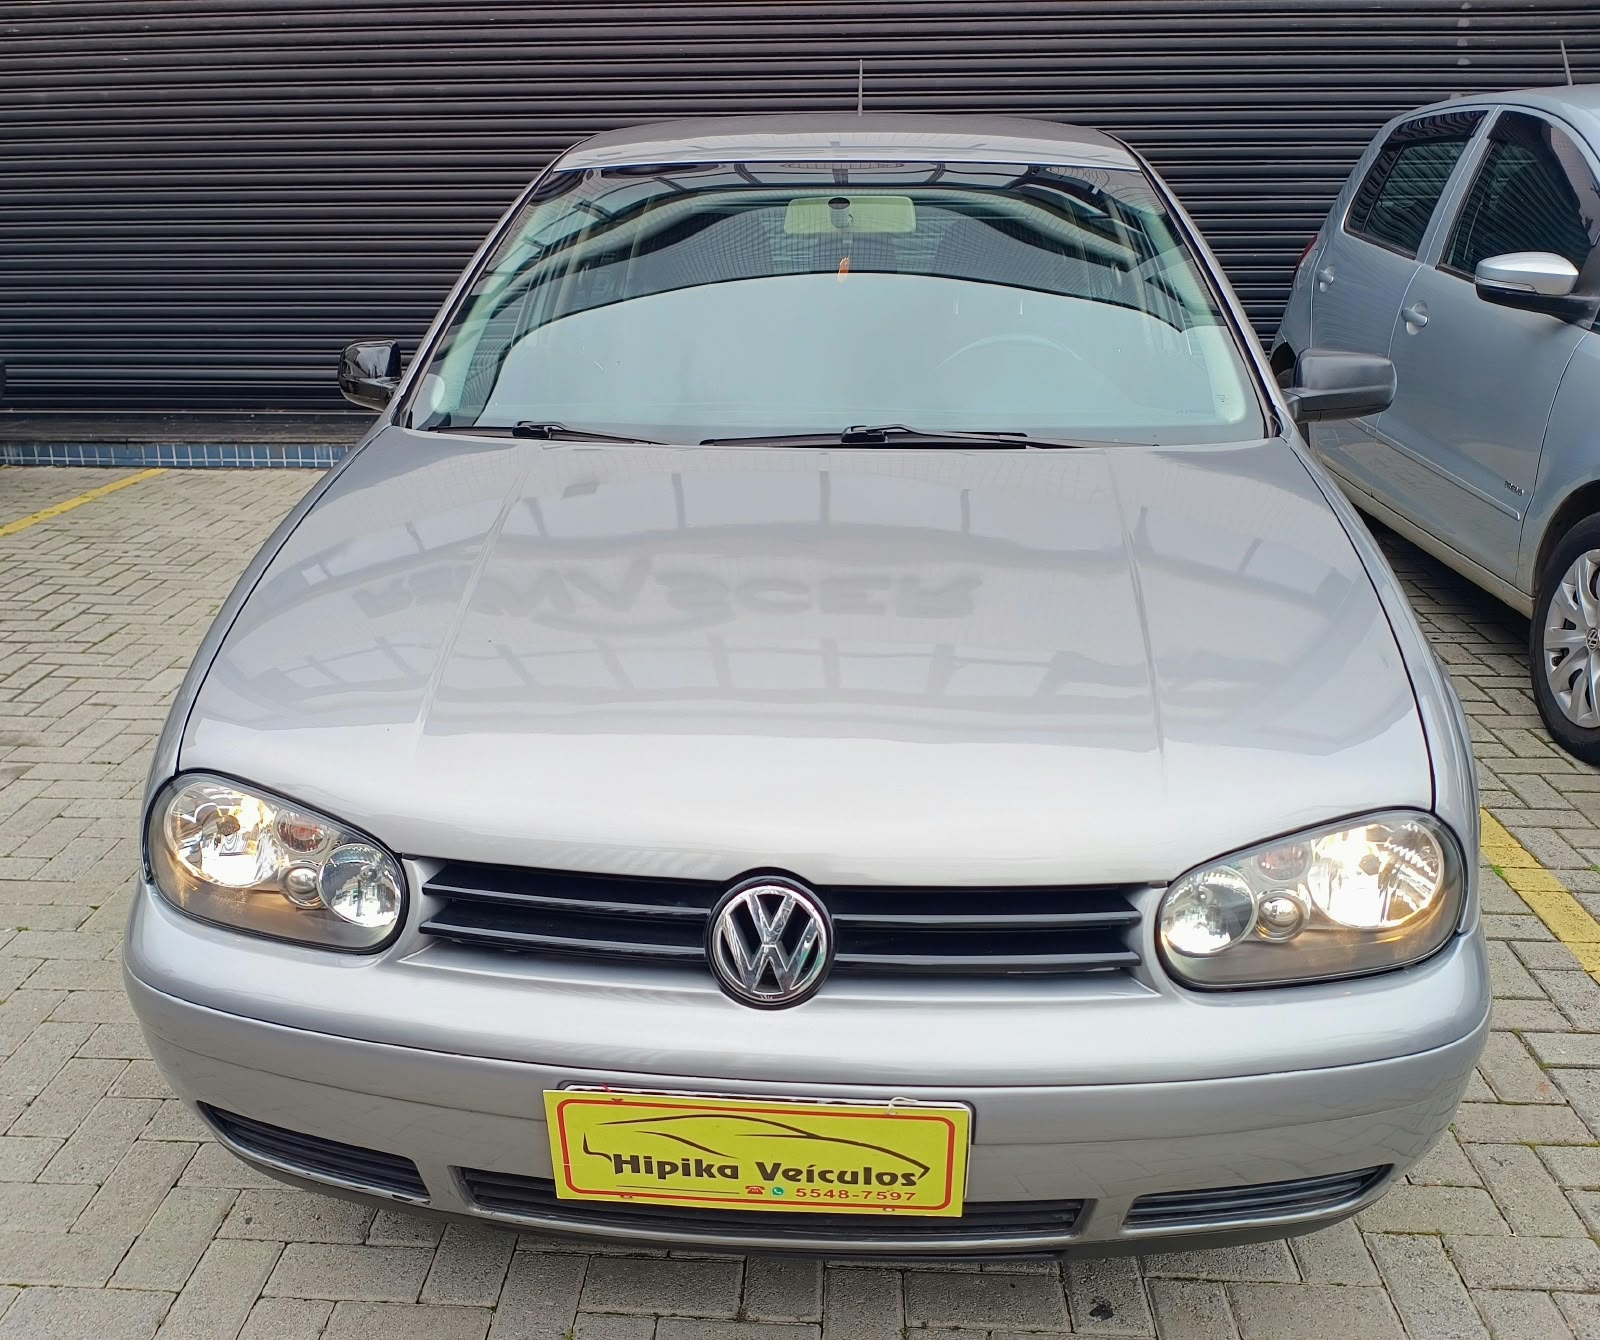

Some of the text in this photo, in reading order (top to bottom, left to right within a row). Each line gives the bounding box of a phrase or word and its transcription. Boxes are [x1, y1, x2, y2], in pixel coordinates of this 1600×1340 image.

[713, 886, 827, 1000] VW
[612, 1153, 918, 1187] Hipika Veículos
[795, 1188, 917, 1201] 5548-7597
